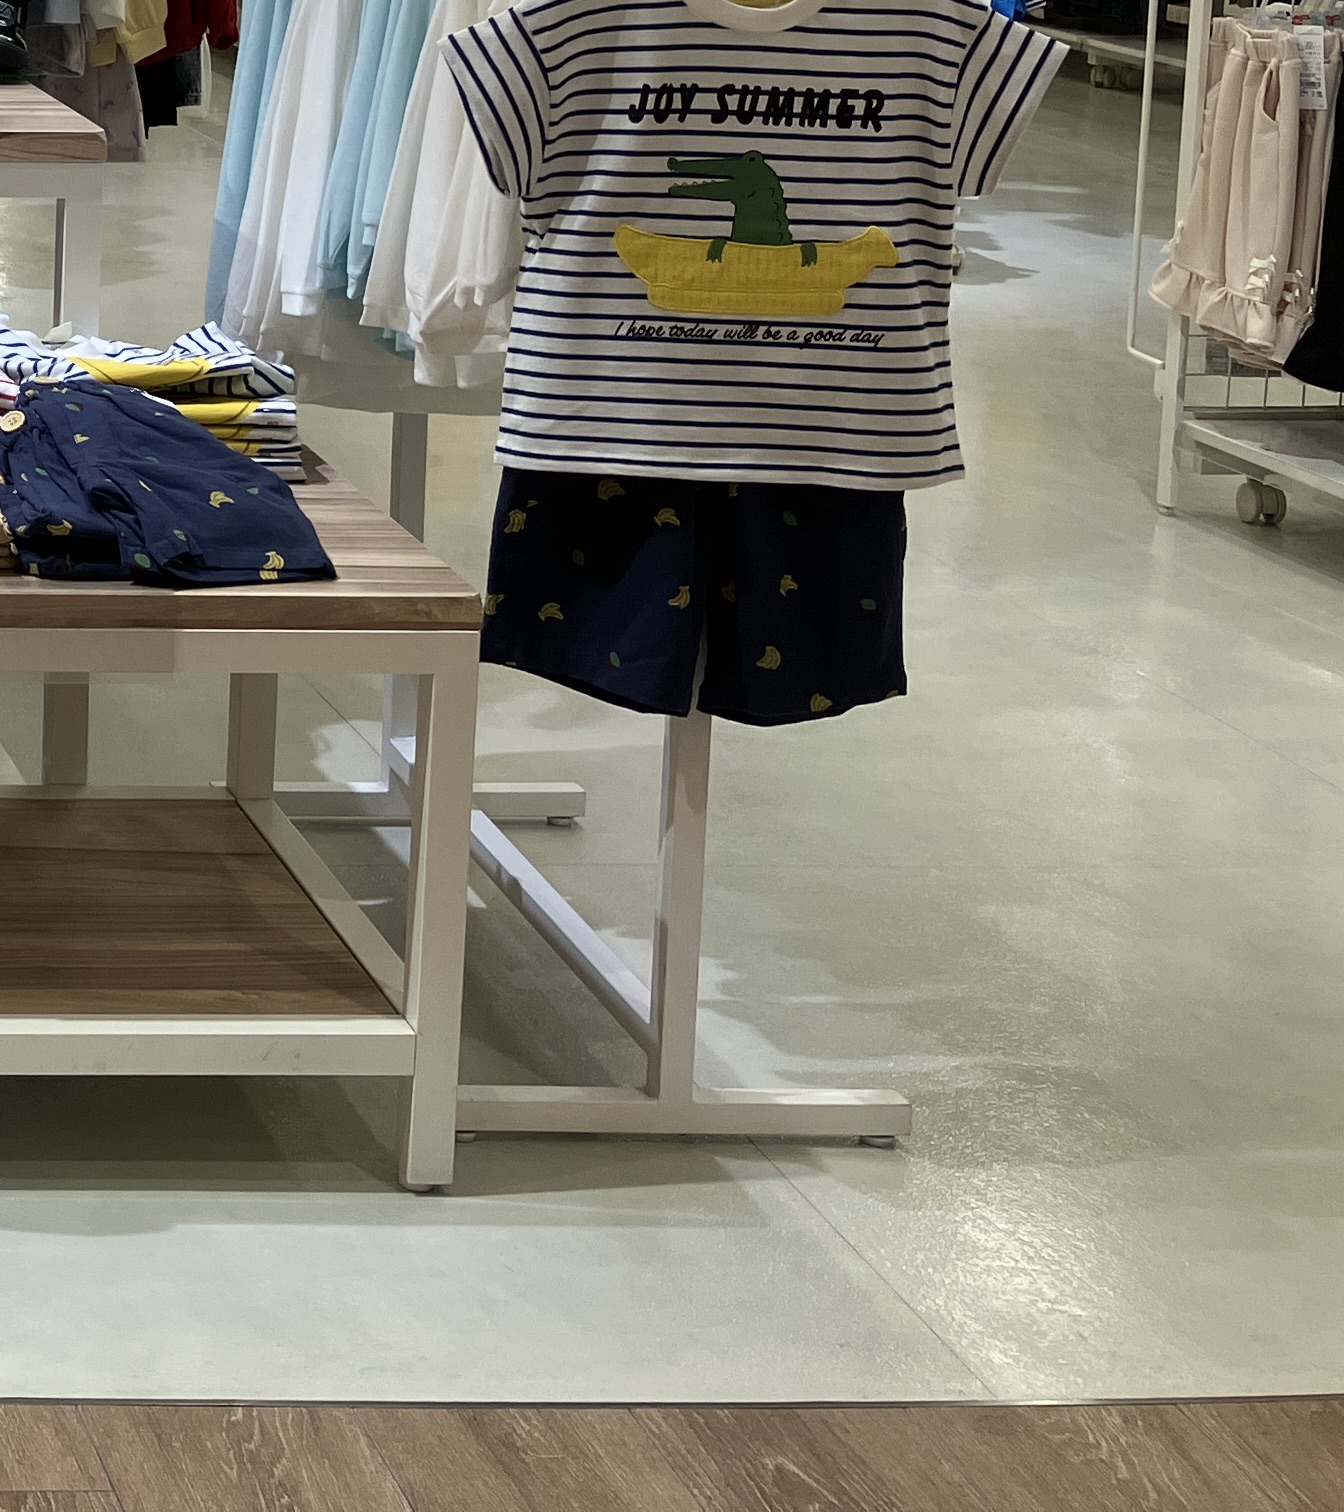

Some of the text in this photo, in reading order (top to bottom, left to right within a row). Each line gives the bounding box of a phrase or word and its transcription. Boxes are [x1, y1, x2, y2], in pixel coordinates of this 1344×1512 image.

[627, 82, 887, 133] JOY SUMMER
[626, 319, 665, 337] hope
[669, 322, 719, 339] today
[723, 323, 758, 340] will
[762, 325, 783, 341] be
[786, 329, 799, 341] a
[799, 329, 846, 349] good
[849, 329, 885, 347] day
